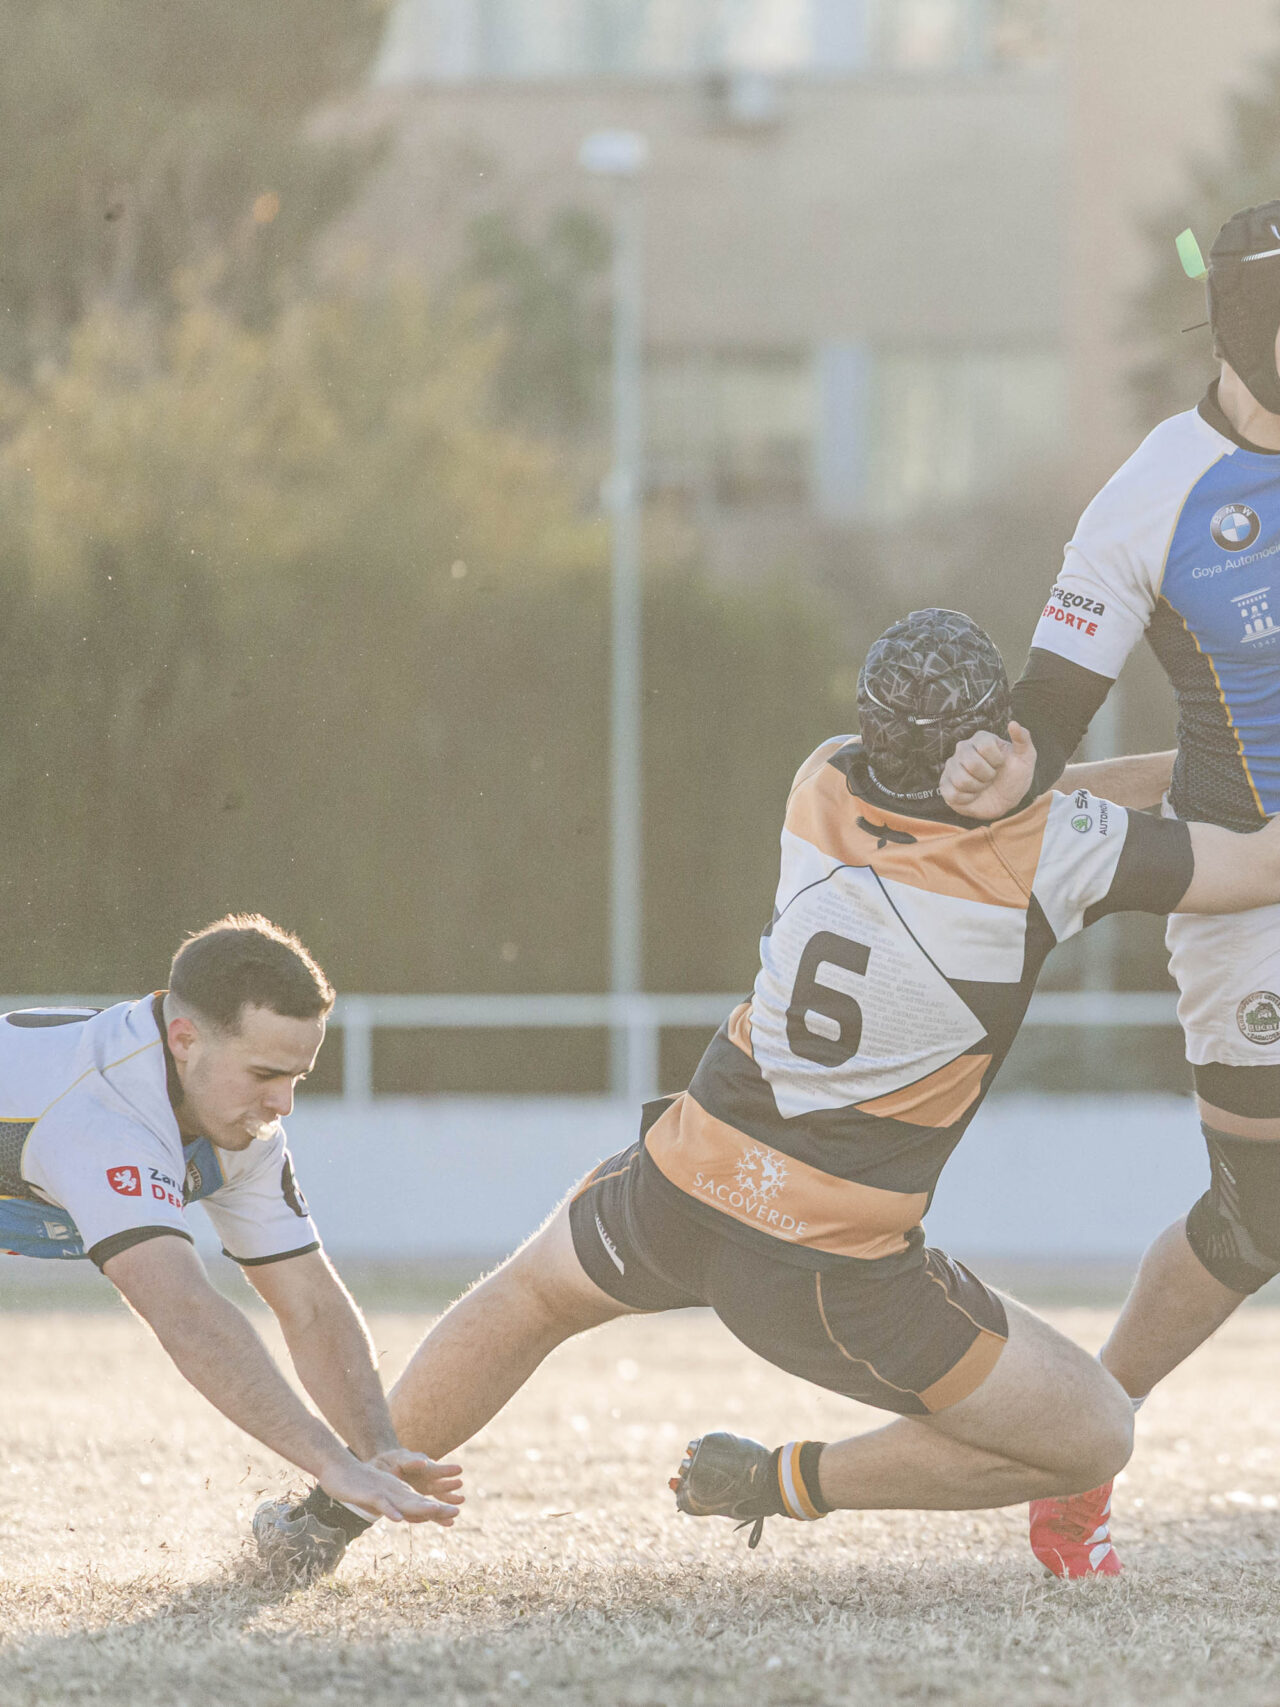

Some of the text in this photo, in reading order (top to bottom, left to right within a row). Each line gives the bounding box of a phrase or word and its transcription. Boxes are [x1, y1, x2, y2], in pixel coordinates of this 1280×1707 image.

[1191, 564, 1223, 580] Goya
[1051, 586, 1106, 616] ragoza
[786, 930, 872, 1068] 6
[692, 1171, 809, 1237] SACOVERDE
